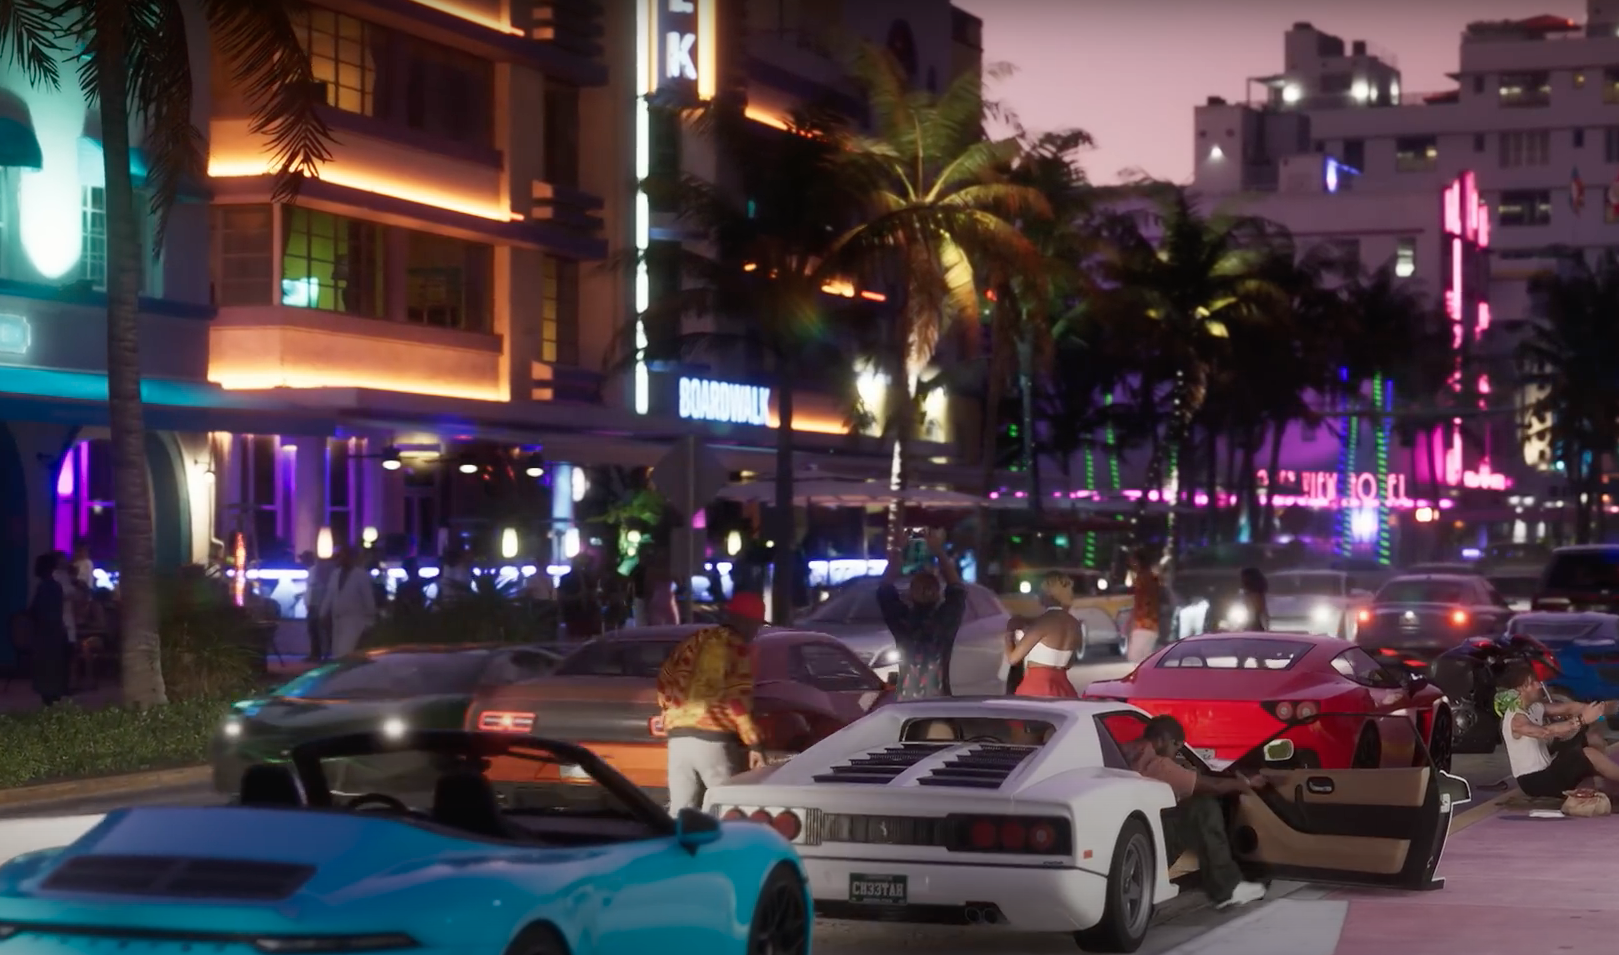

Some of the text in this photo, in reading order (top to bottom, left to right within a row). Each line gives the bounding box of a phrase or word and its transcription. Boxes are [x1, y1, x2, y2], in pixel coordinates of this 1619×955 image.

[666, 0, 697, 80] K
[679, 377, 770, 426] BOARDWALK
[1348, 472, 1406, 500] OEL
